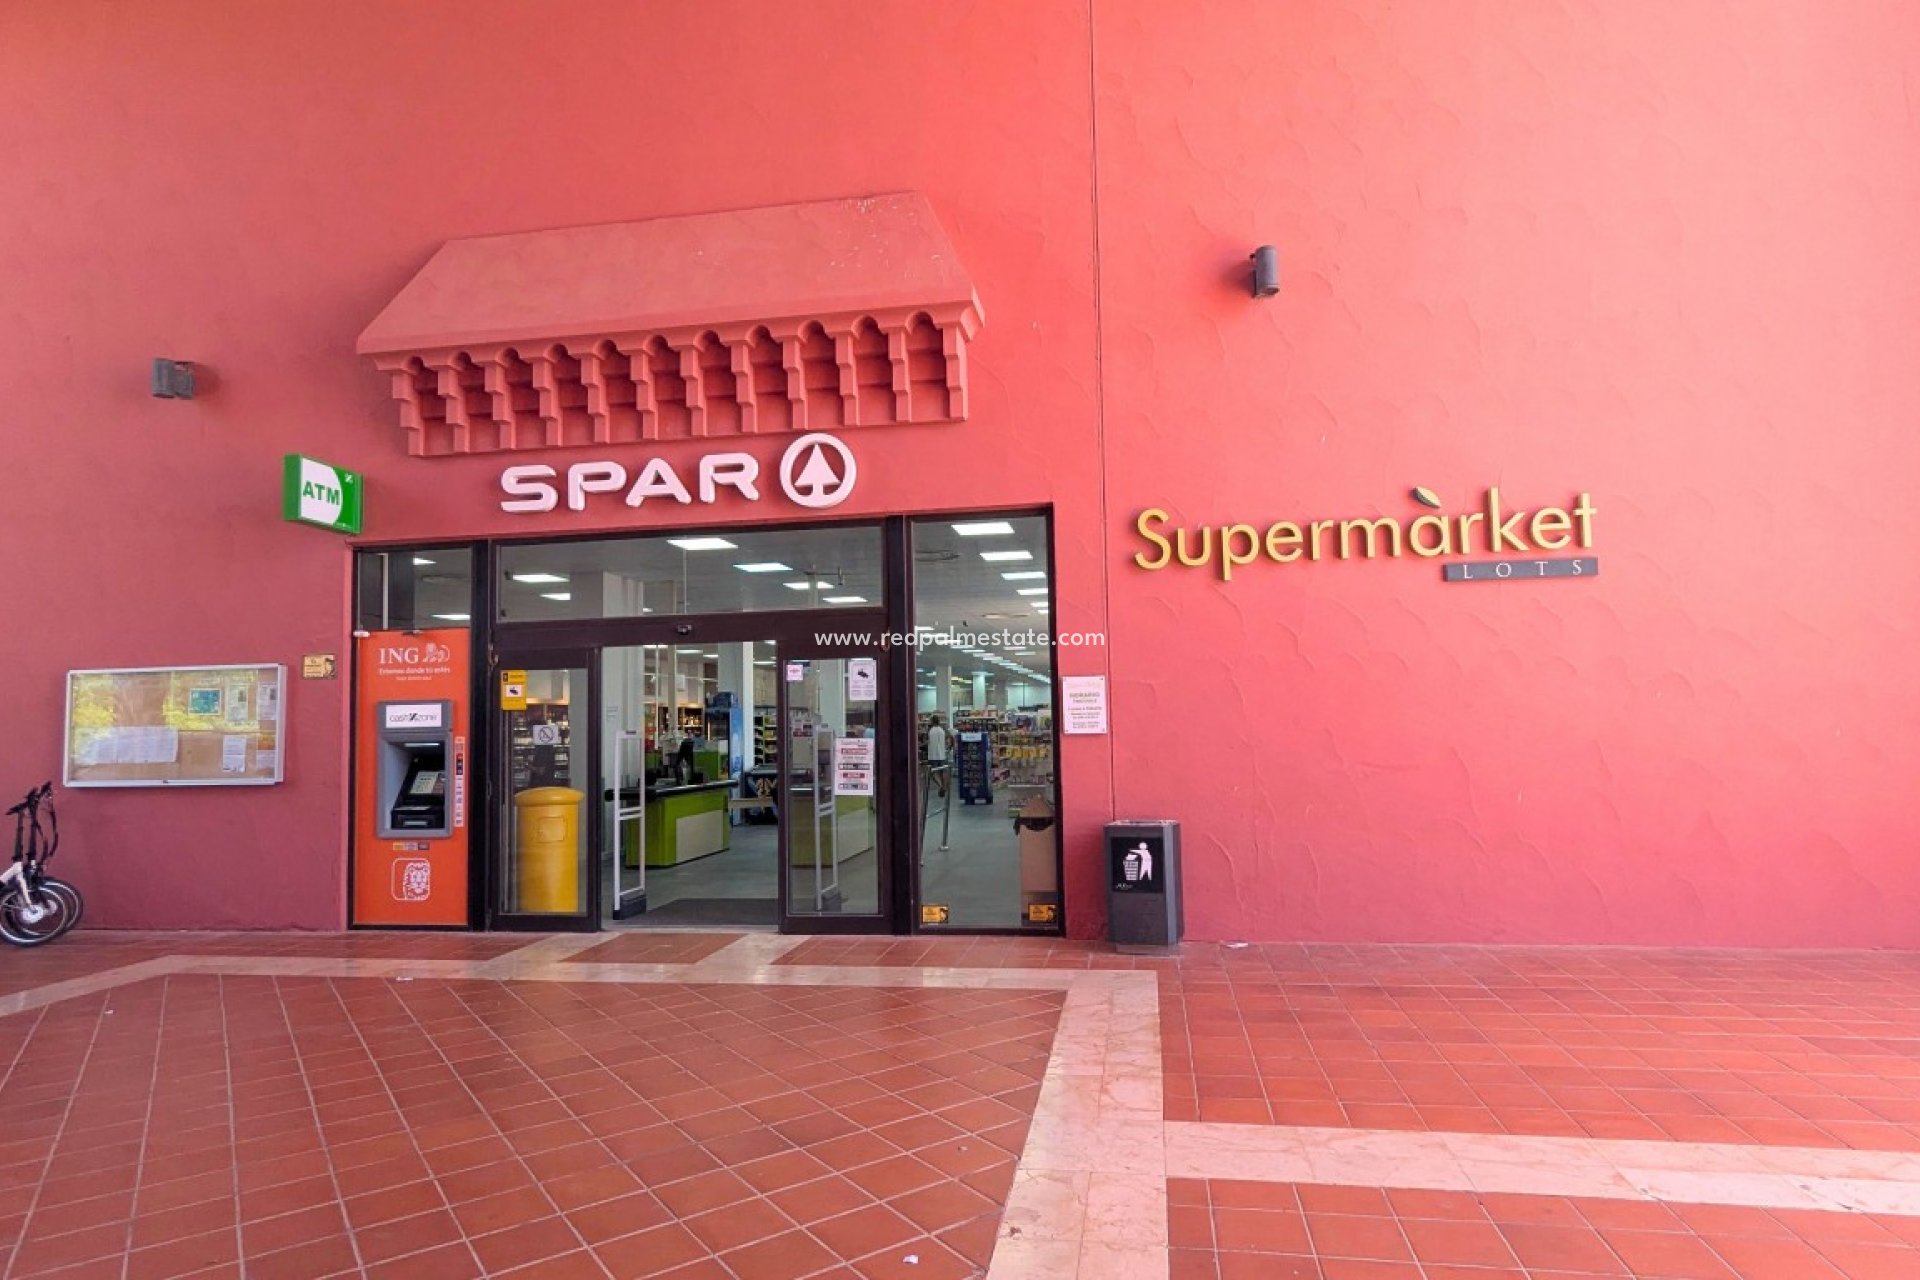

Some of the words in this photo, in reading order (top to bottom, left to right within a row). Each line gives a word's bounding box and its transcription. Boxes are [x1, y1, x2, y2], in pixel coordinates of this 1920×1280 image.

[302, 480, 341, 506] ATM
[501, 451, 760, 514] SPAR
[1462, 558, 1583, 580] LOTS
[379, 647, 419, 665] ING
